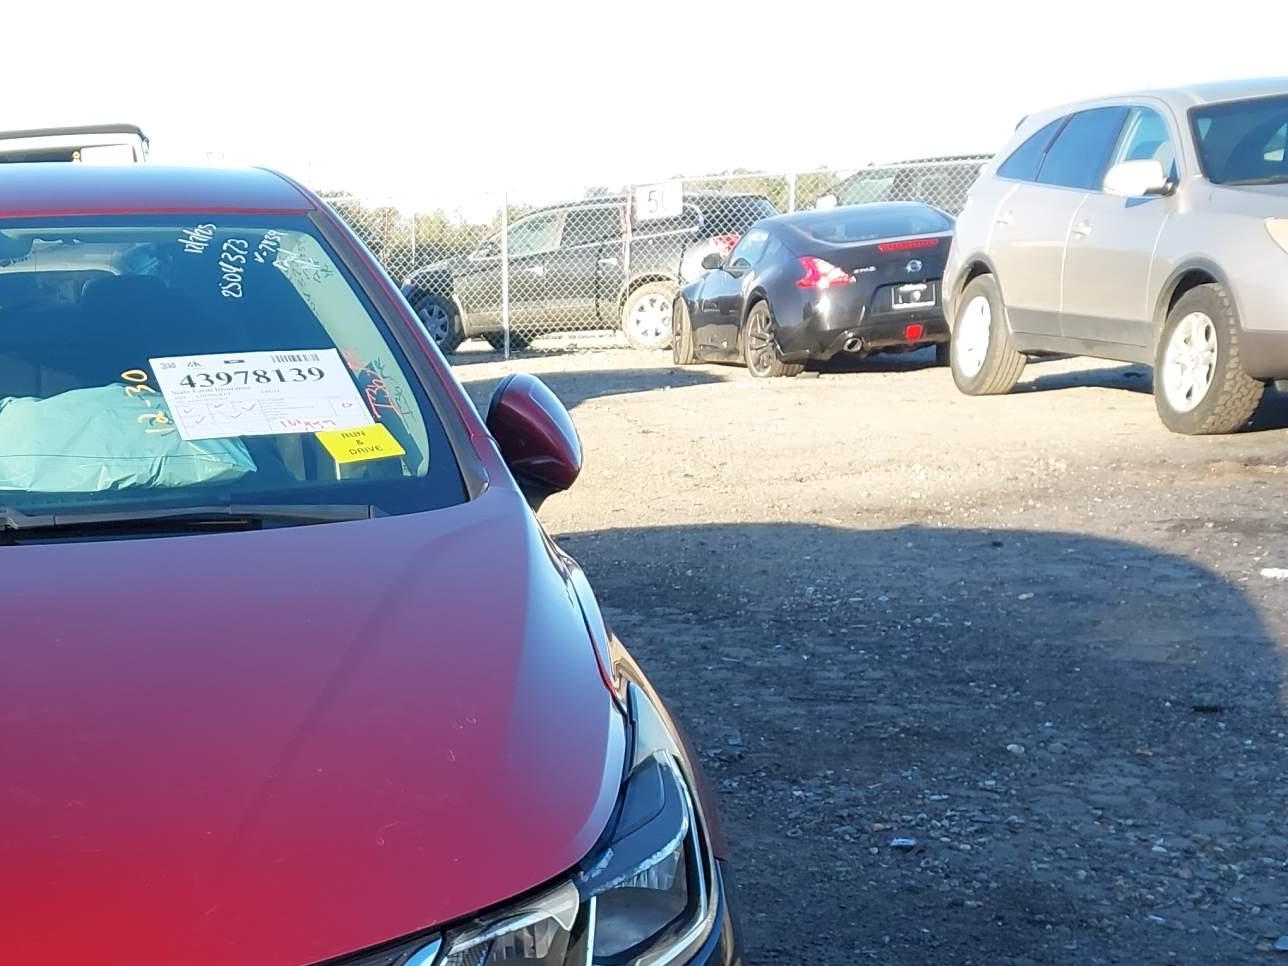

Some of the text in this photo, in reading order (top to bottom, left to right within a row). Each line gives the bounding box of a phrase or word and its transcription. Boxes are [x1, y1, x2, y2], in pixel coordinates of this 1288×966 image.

[218, 238, 249, 298] 2504373
[180, 366, 325, 388] 43978139
[341, 430, 366, 439] RUN
[348, 445, 384, 456] DRIVE
